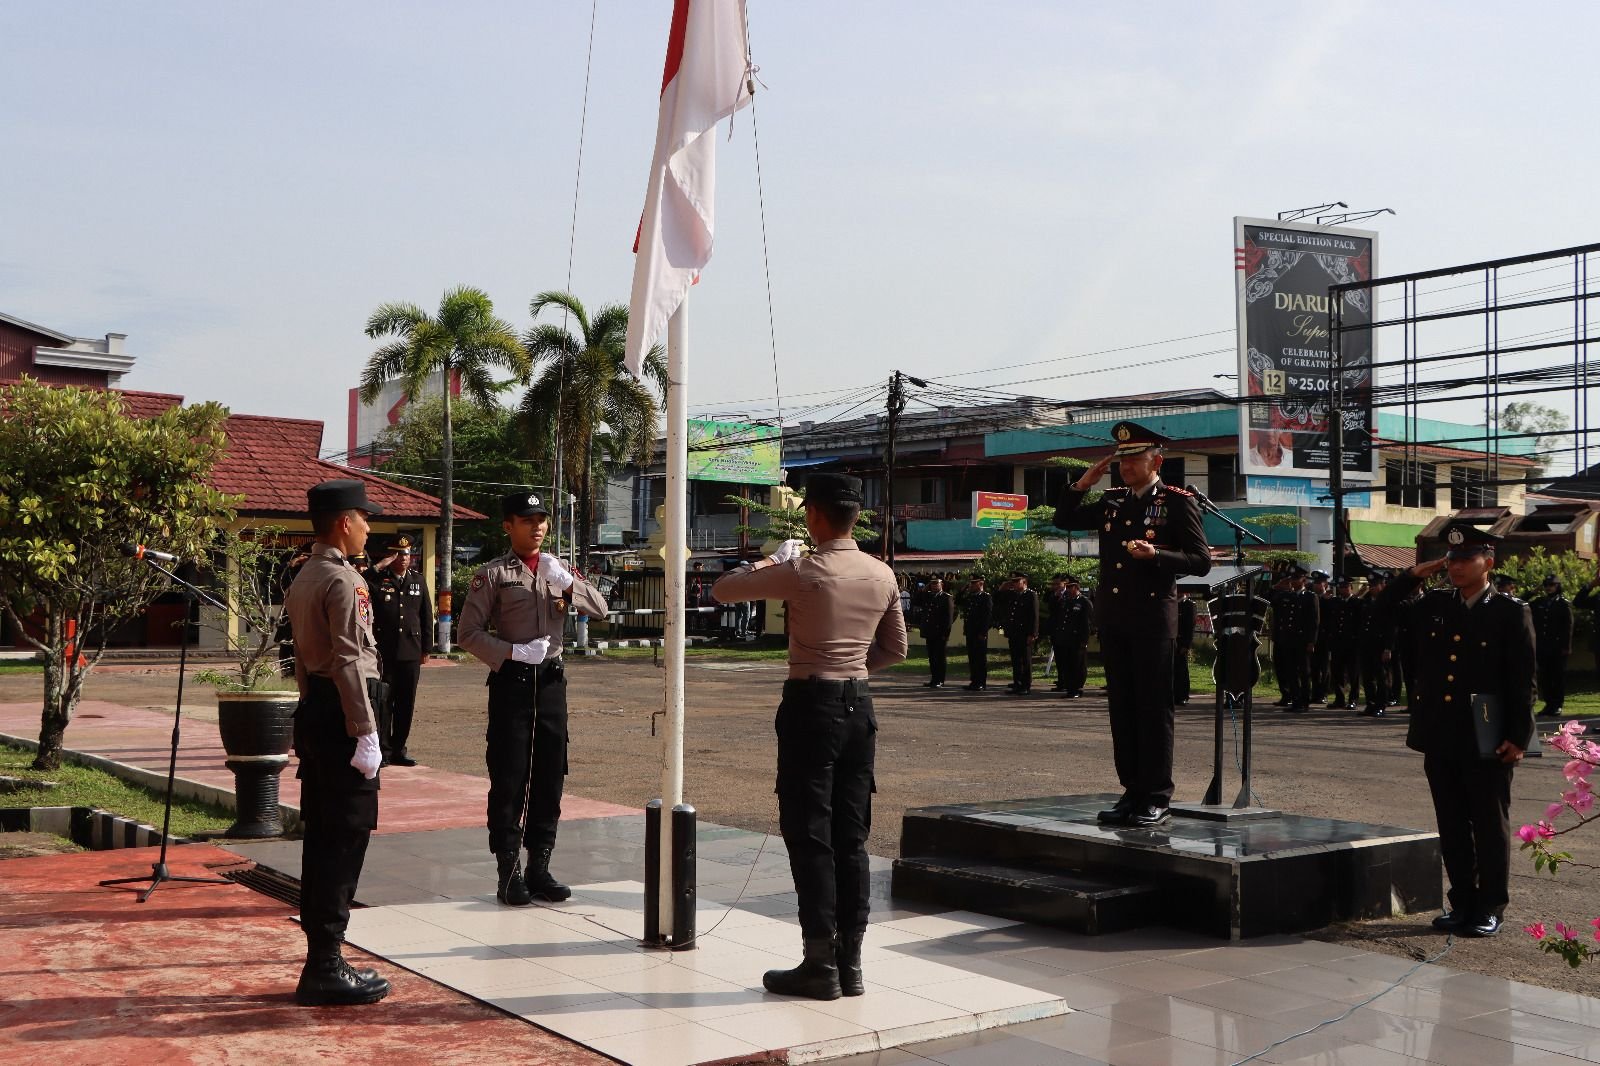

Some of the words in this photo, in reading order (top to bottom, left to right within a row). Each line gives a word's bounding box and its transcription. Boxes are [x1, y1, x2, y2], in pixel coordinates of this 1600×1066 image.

[1259, 231, 1296, 244] SPECIAL
[1297, 235, 1332, 247] EDITION
[1334, 239, 1357, 250] PACK
[1287, 314, 1329, 345] Supe
[1281, 357, 1292, 366] OF
[1266, 373, 1282, 388] 12
[1288, 376, 1298, 387] Rp
[1254, 479, 1306, 496] Freshmart
